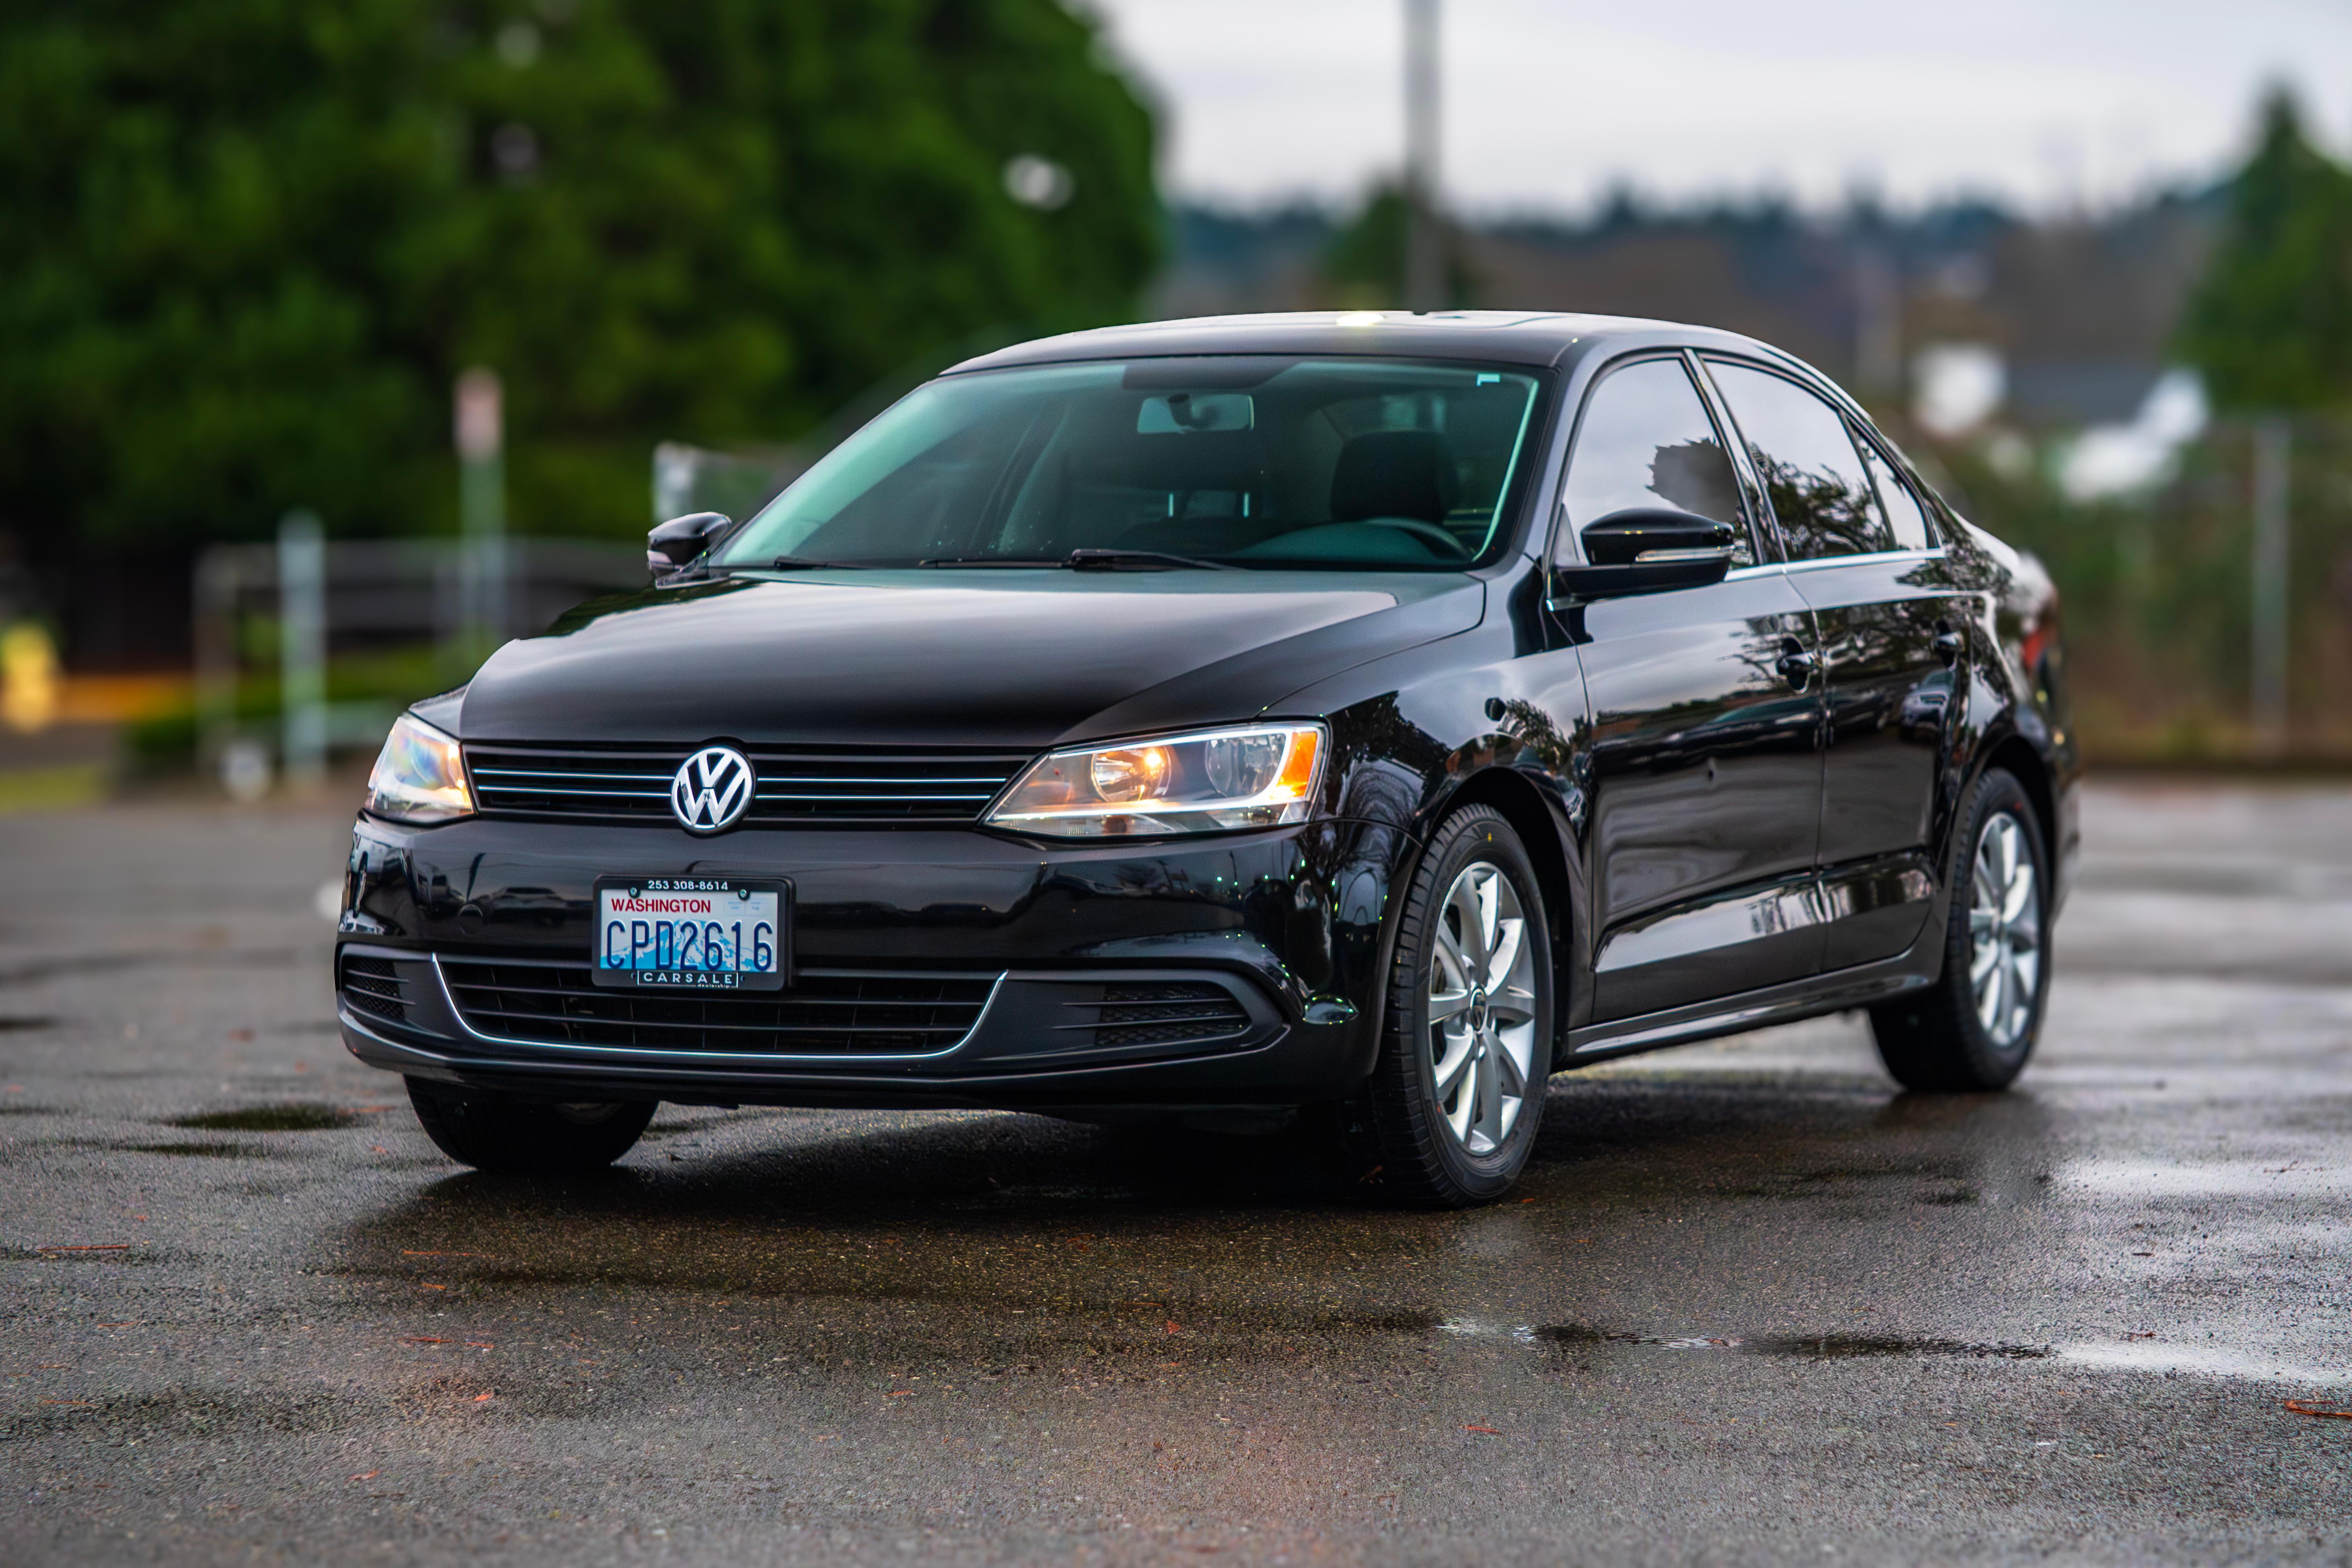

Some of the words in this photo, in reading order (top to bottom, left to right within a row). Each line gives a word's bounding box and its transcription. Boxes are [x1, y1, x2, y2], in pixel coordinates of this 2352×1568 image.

[674, 748, 750, 828] VW
[648, 880, 669, 890] 253
[673, 880, 728, 890] 308-8614
[611, 898, 711, 913] WASHINGTON
[607, 920, 773, 971] CPD2616
[644, 972, 732, 984] CARSALE
